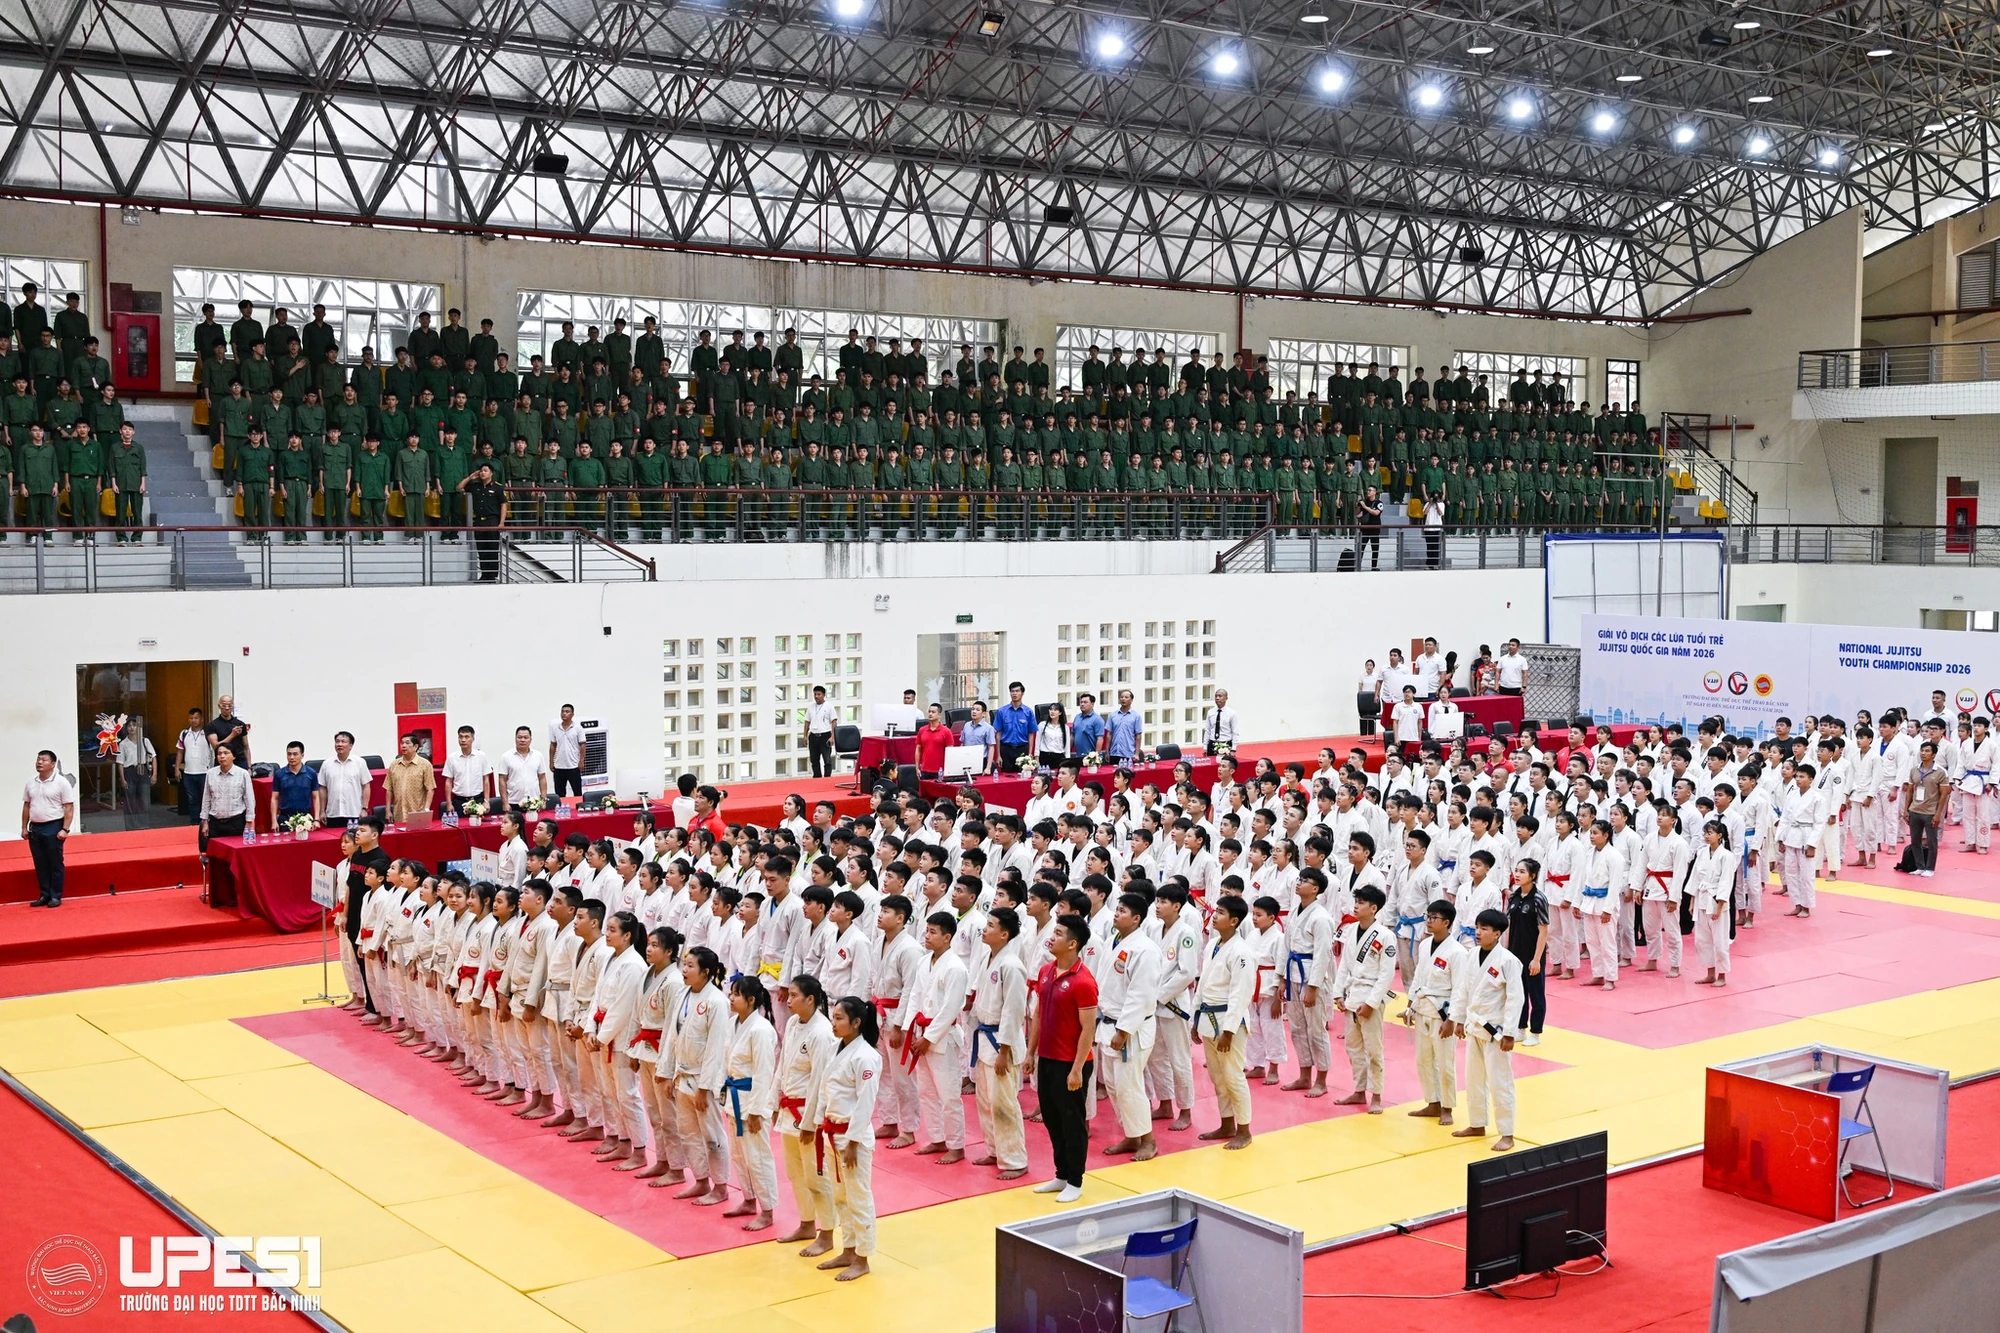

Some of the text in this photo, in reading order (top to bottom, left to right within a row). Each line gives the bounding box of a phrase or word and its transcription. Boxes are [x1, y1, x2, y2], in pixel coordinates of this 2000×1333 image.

[1616, 629, 1628, 640] VÔ
[1651, 631, 1667, 642] CÁC
[1598, 642, 1715, 658] JUJITSU QUỐC GIA NĂM 2026
[1839, 643, 1922, 657] NATIONAL JUJITSU
[1839, 657, 1971, 675] YOUTH CHAMPIONSHIP 2026
